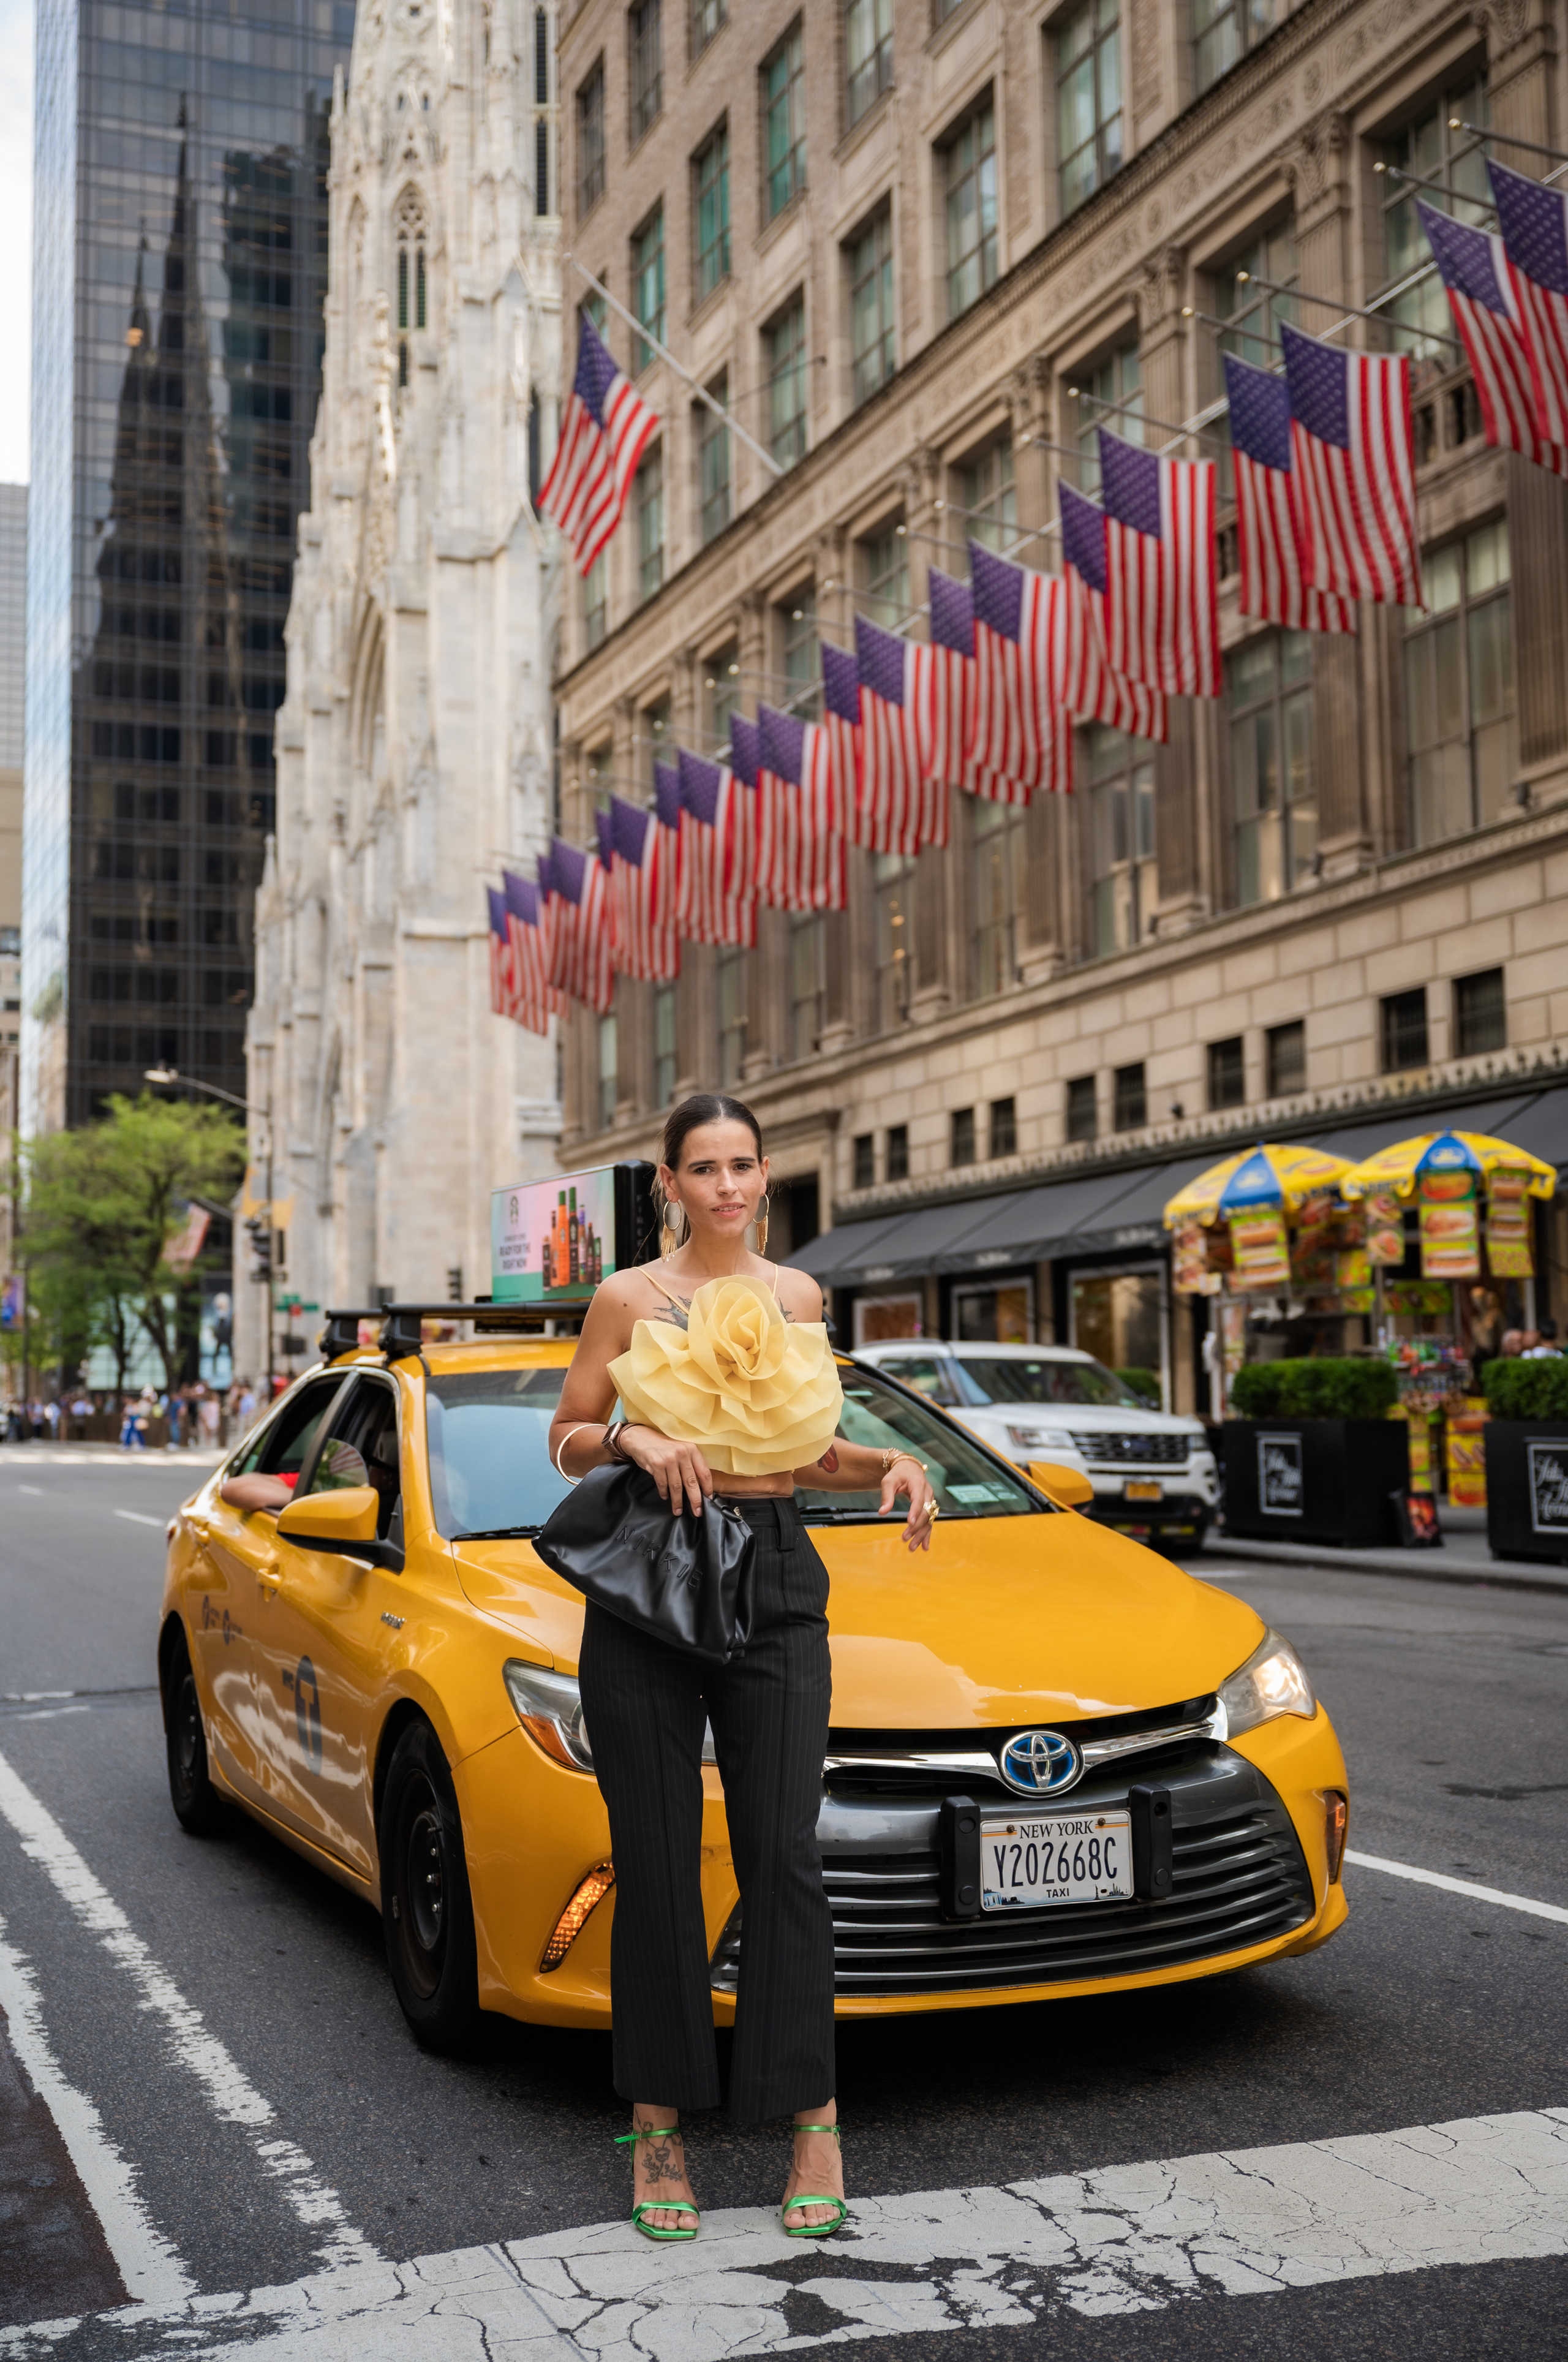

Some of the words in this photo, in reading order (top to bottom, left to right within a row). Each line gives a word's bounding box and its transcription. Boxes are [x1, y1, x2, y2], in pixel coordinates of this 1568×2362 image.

[615, 1525, 703, 1589] NIKKIE
[1019, 1824, 1054, 1839] NEW
[1057, 1821, 1094, 1836] YORK
[993, 1836, 1118, 1888] Y202668C
[1046, 1888, 1070, 1898] TAXI
